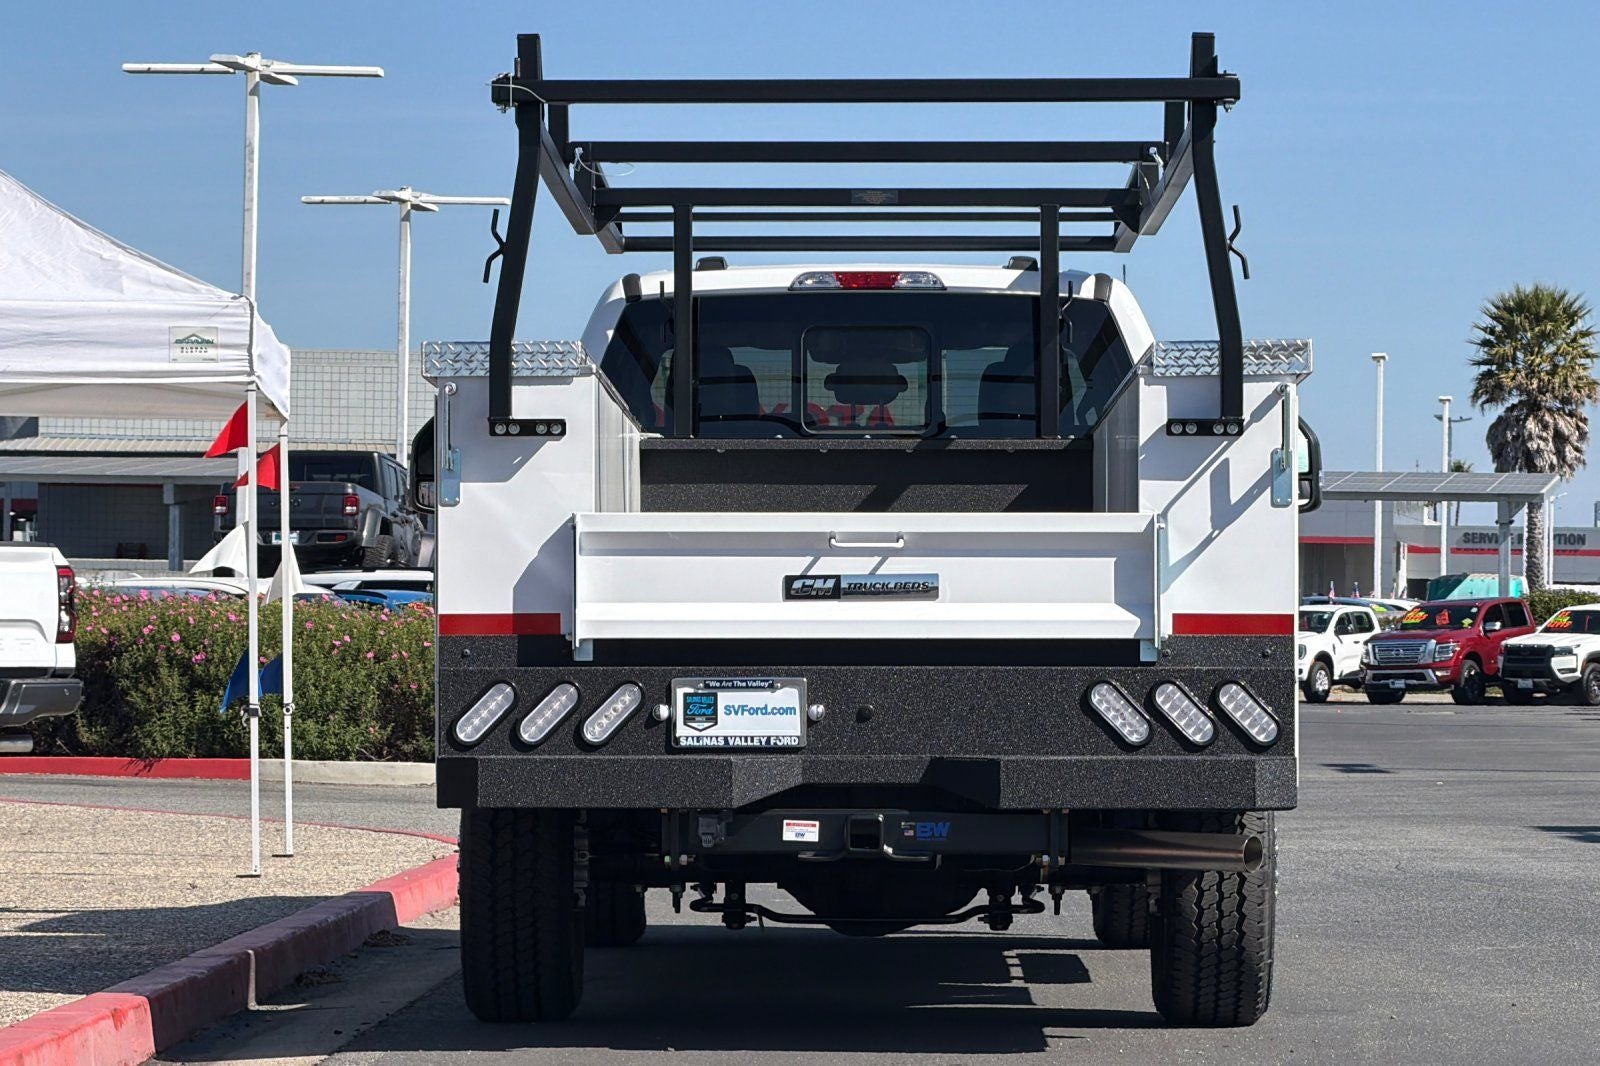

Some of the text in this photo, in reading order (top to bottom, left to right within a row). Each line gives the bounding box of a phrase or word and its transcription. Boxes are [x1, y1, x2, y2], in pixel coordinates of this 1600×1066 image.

[1463, 532, 1514, 545] SERVI
[790, 578, 930, 596] CM TRUCK BEDS
[686, 703, 714, 715] Ford
[723, 704, 797, 716] SVFord.com
[679, 736, 799, 746] SALINAS VALLEY FORD
